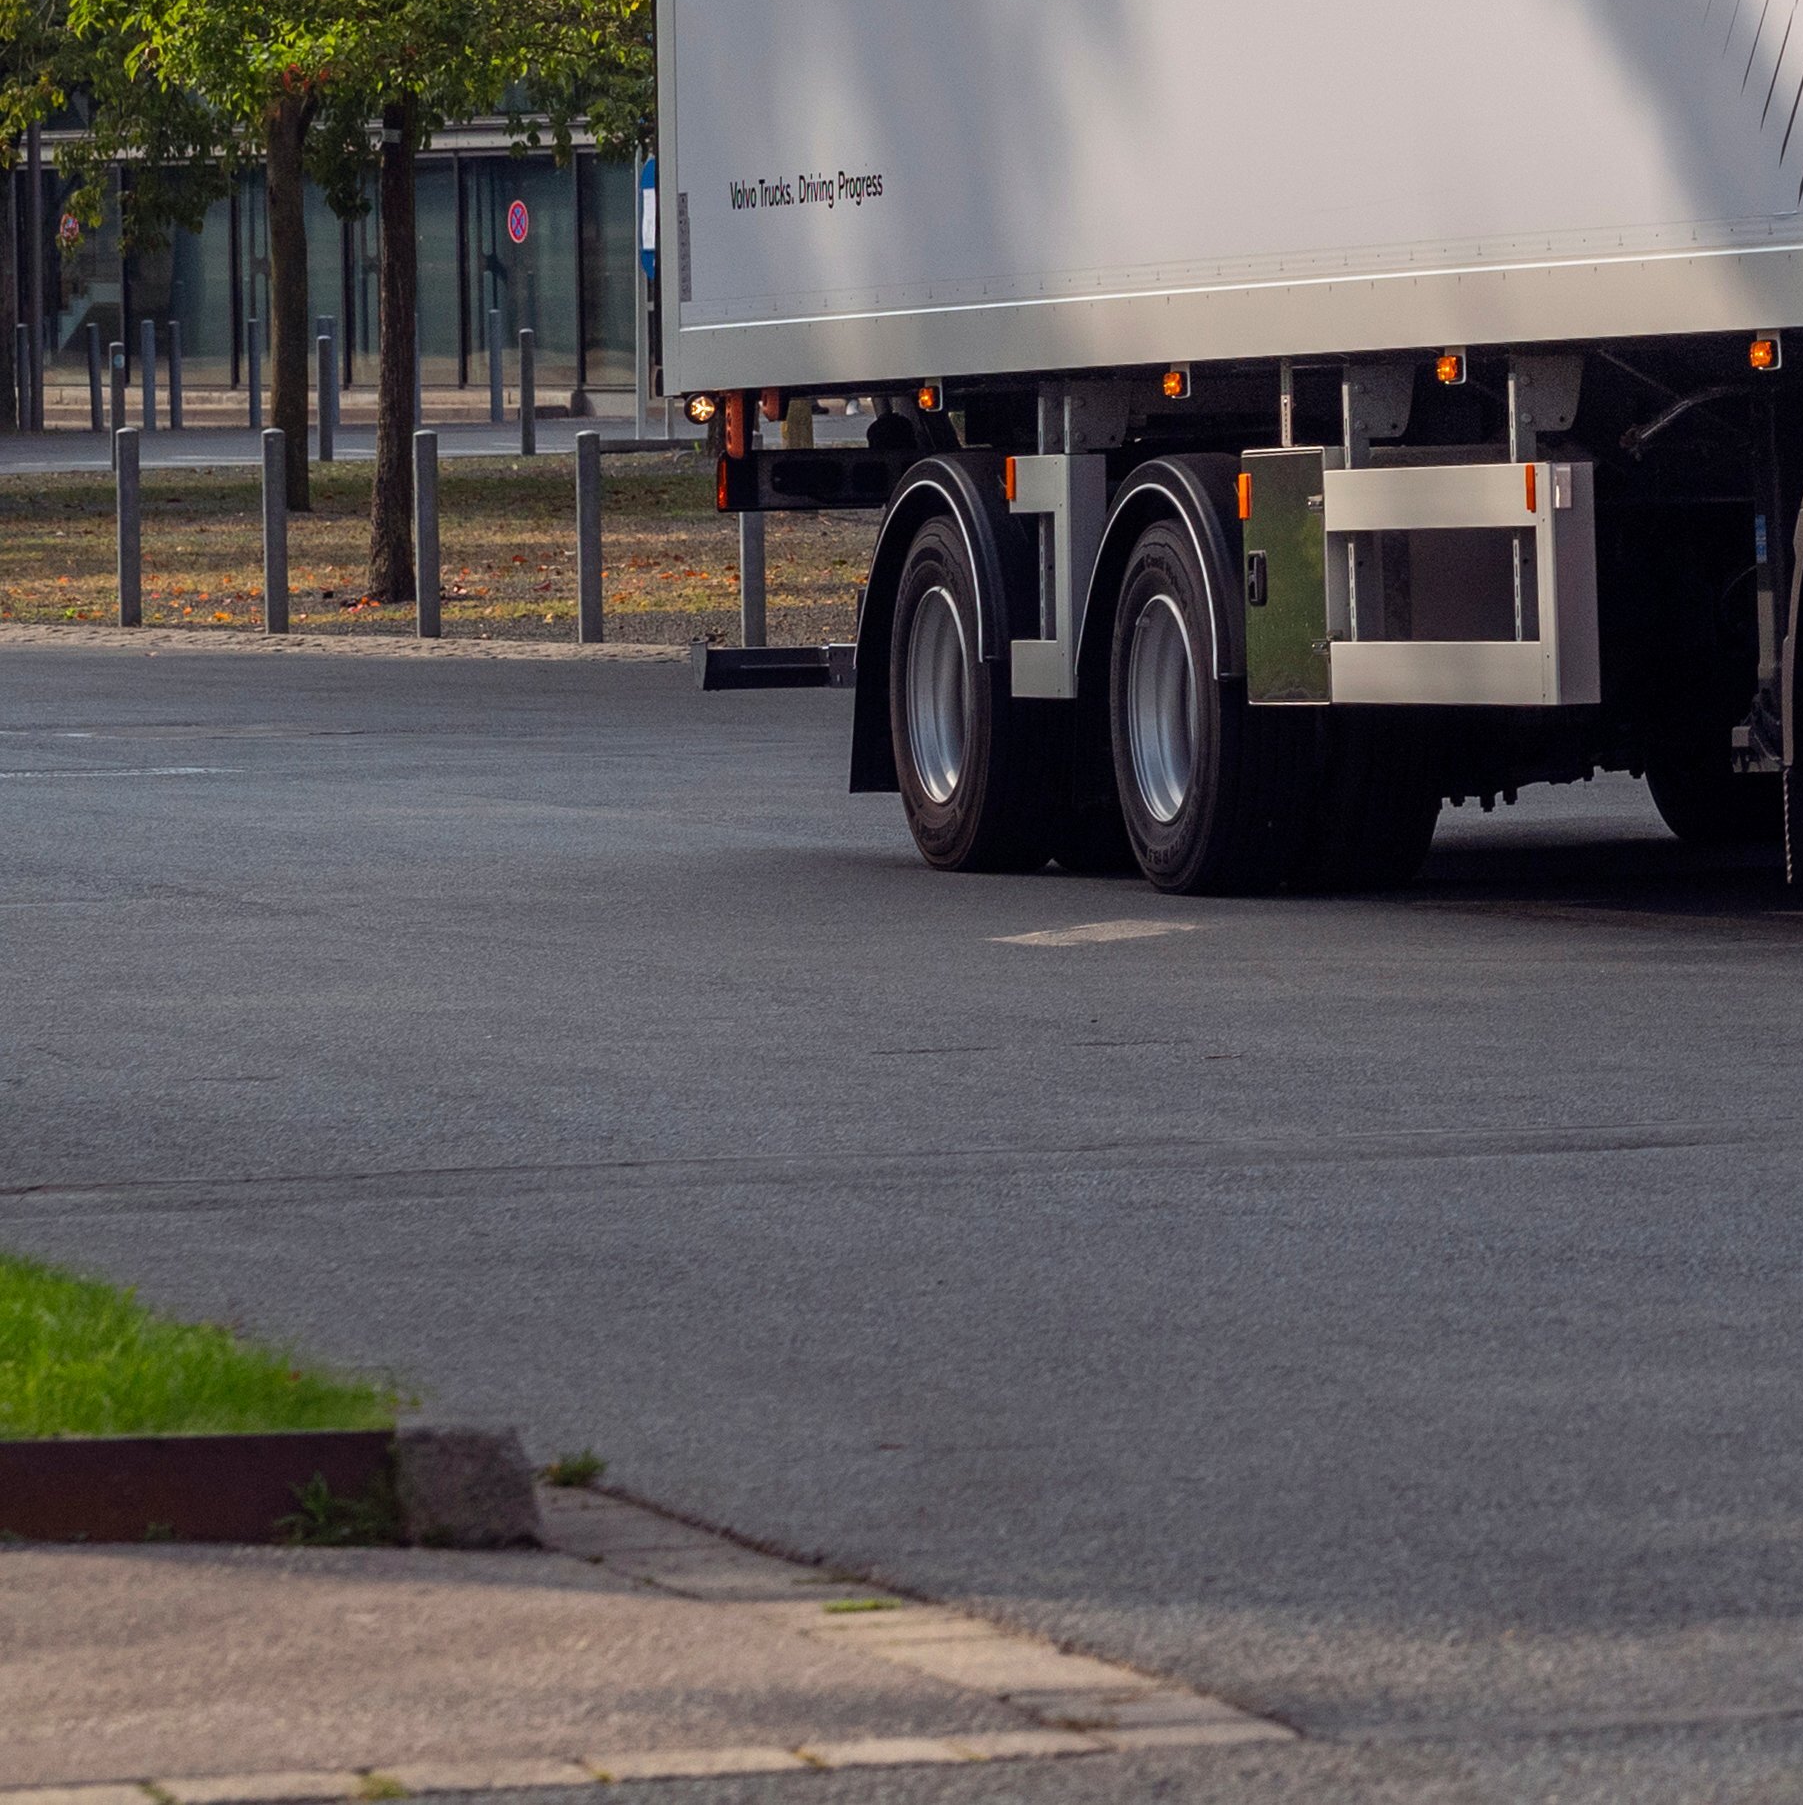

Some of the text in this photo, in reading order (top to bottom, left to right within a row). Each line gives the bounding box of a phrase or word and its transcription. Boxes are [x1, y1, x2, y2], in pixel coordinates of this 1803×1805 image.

[729, 170, 883, 210] Volvo Trucks. Driving Progress
